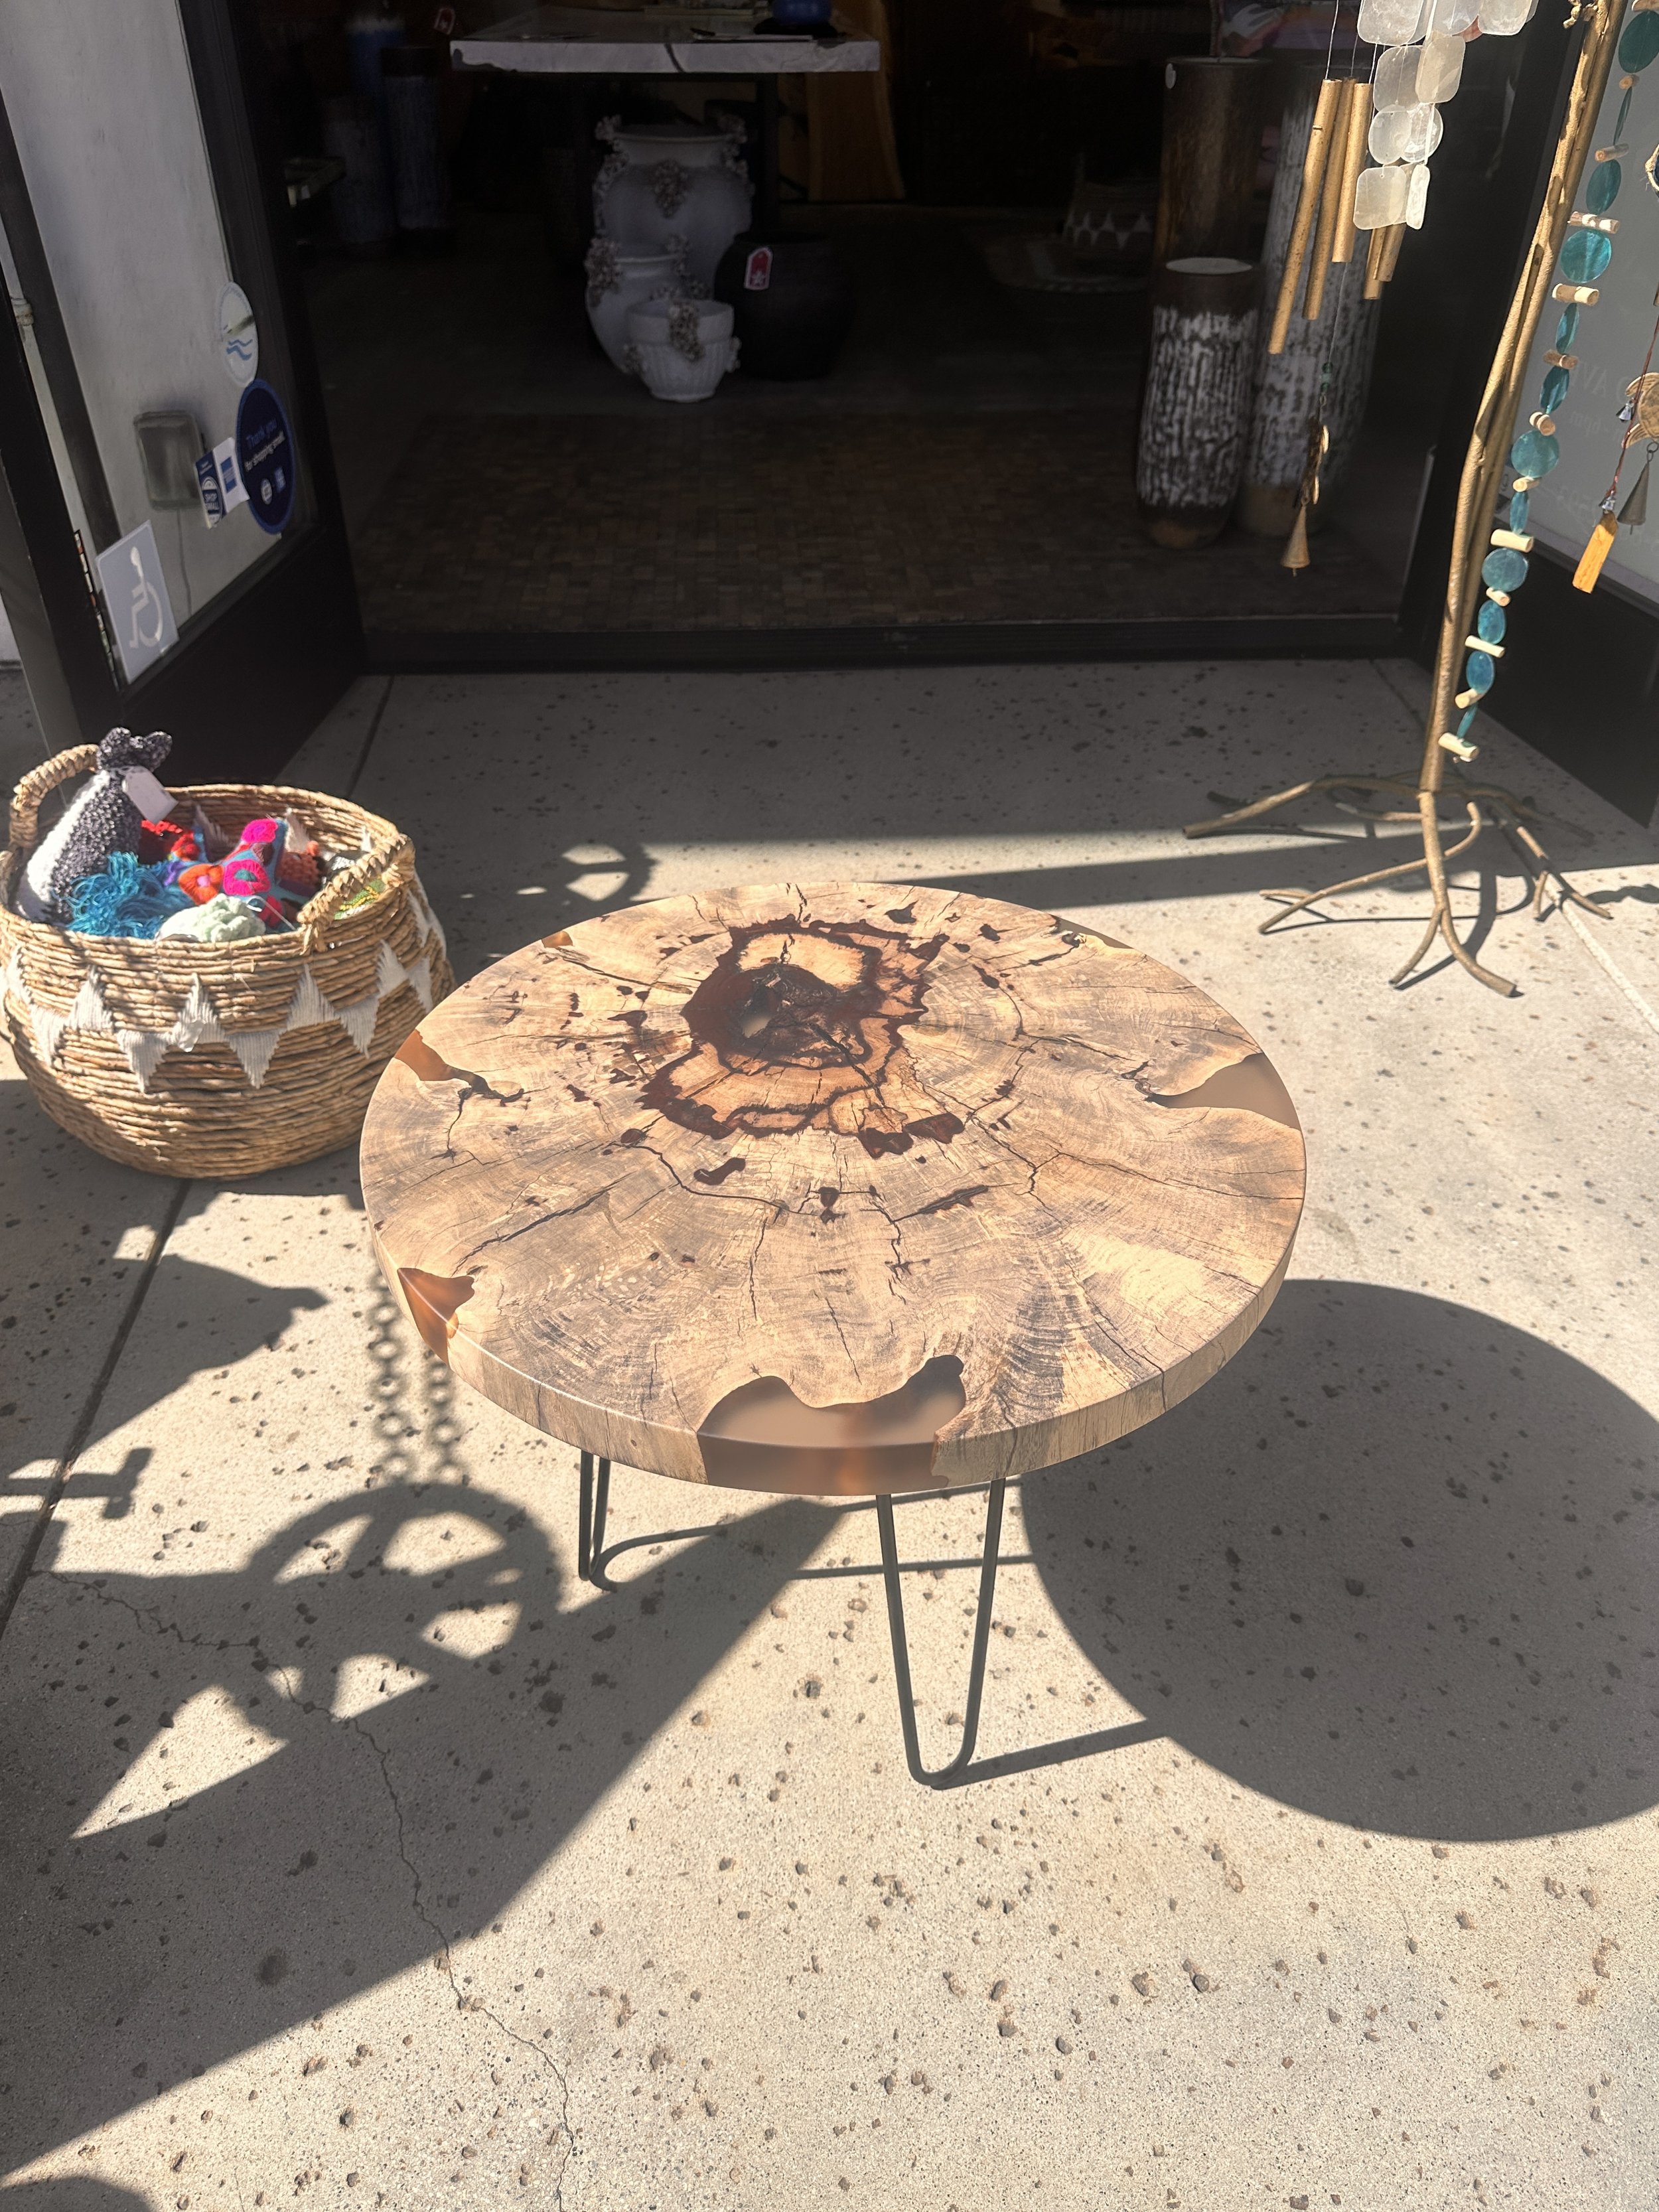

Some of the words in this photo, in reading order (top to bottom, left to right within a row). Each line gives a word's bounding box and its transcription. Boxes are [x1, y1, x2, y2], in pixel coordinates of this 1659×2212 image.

[246, 425, 265, 450] Thank
[265, 419, 277, 438] you
[252, 443, 274, 466] shopping
[204, 492, 218, 502] SHOP
